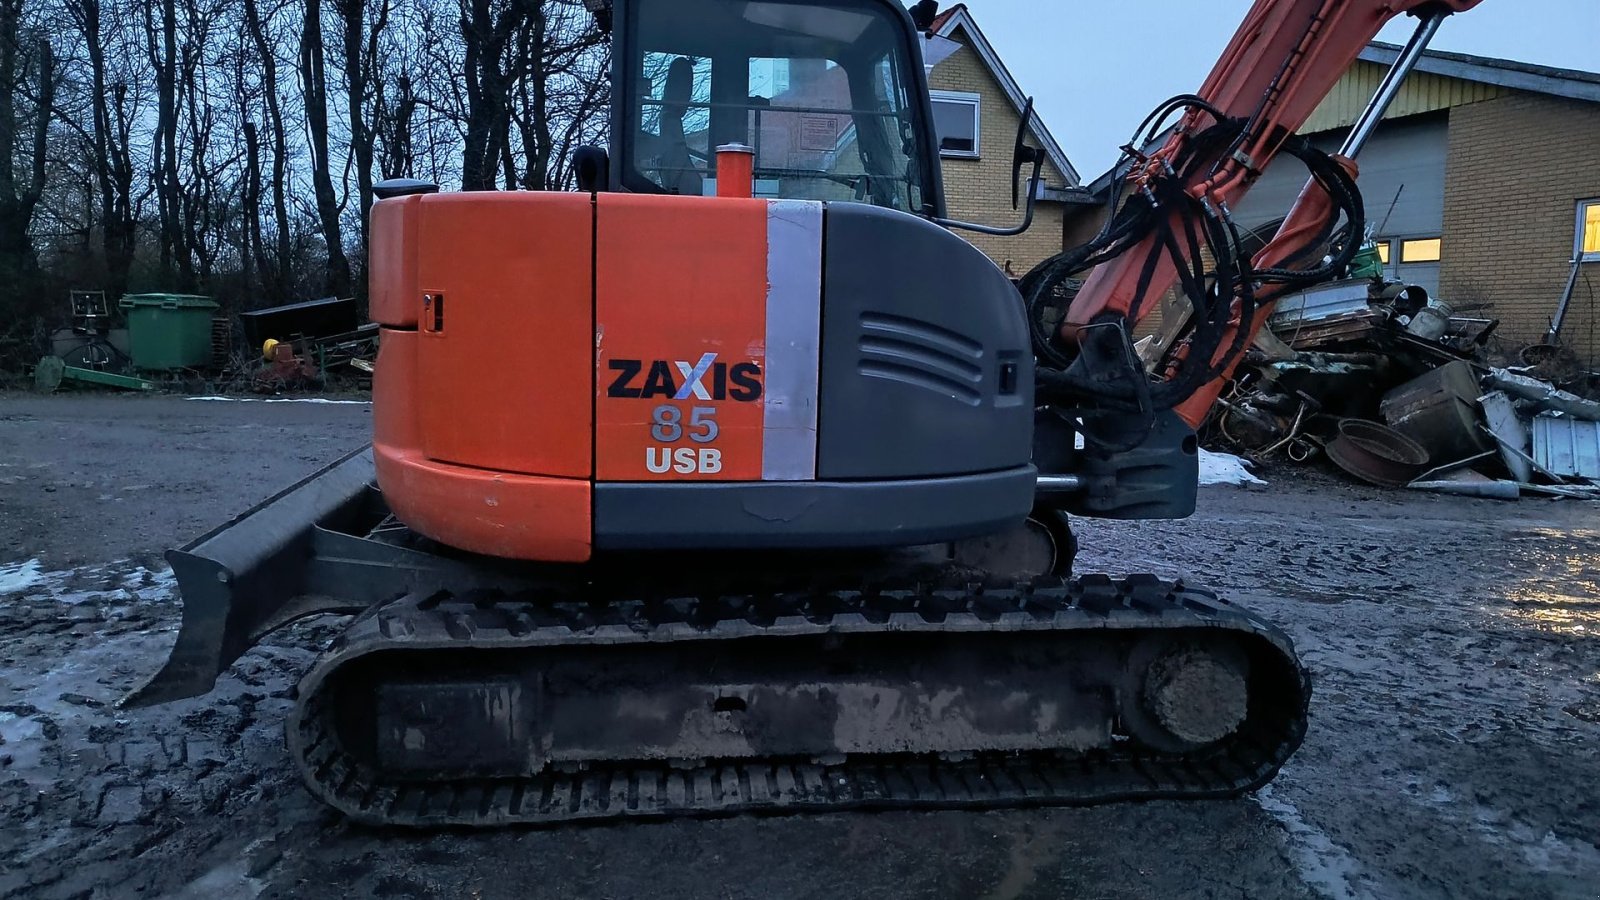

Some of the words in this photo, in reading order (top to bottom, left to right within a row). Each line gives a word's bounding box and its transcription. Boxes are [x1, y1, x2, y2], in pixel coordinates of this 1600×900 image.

[607, 352, 762, 402] ZAXIS
[651, 404, 719, 443] 85
[646, 447, 722, 474] USB
